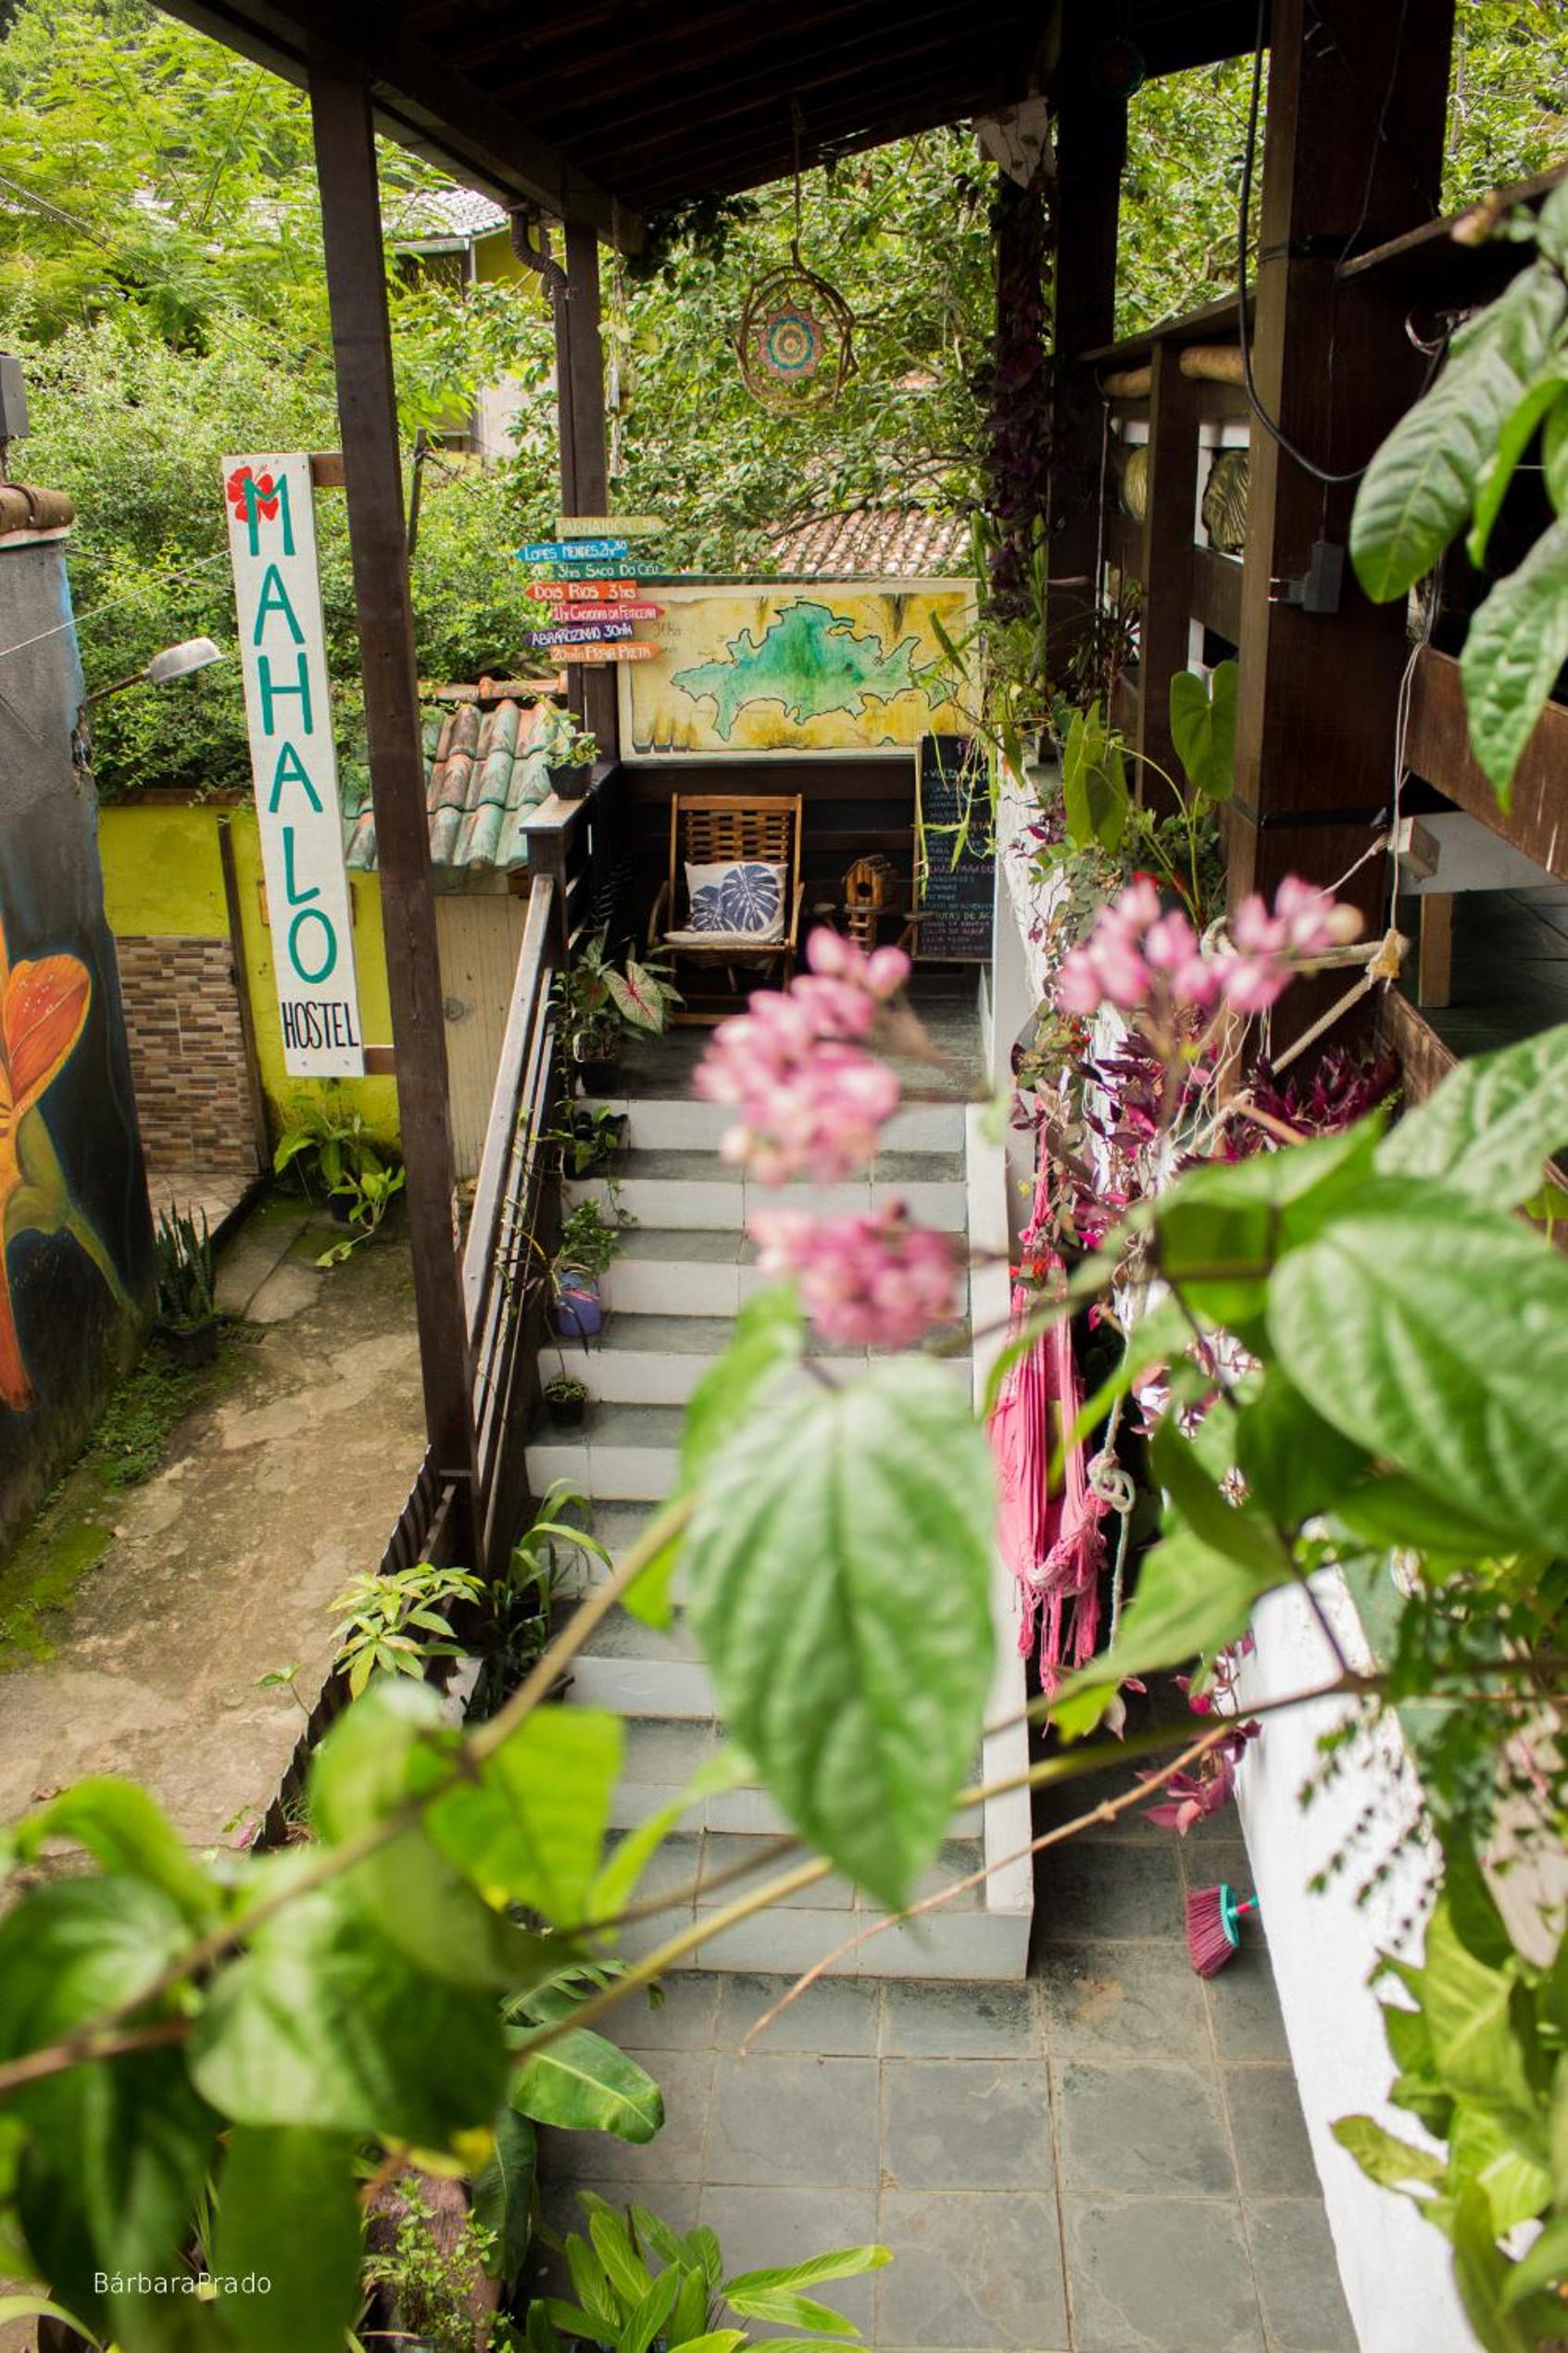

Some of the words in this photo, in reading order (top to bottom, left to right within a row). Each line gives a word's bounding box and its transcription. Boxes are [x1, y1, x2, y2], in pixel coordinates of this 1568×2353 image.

[524, 546, 557, 560] LOPES
[562, 545, 599, 560] MENDES
[585, 564, 615, 578] SACO
[619, 563, 636, 576] DO
[637, 562, 659, 573] CÉU
[534, 585, 564, 599] DOIS
[569, 584, 600, 599] RIOS
[617, 646, 652, 661] PRETA
[243, 472, 338, 984] MAHALO
[282, 1000, 360, 1051] HOSTEL
